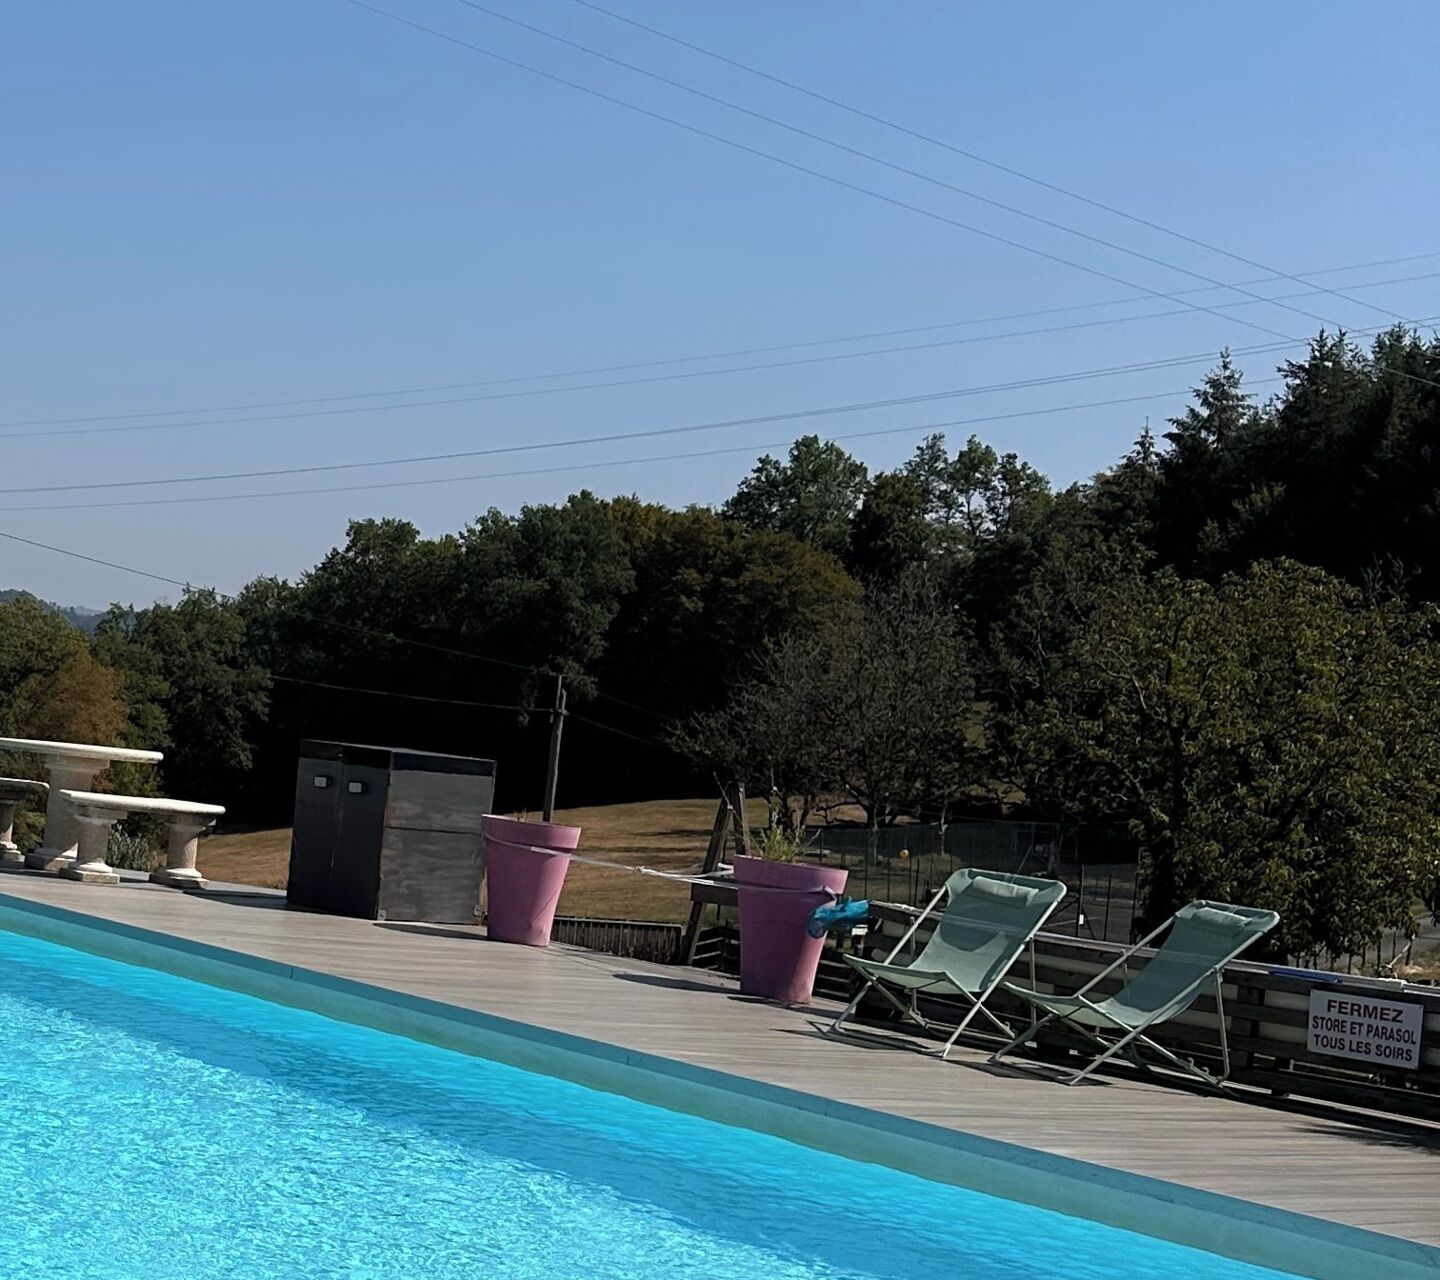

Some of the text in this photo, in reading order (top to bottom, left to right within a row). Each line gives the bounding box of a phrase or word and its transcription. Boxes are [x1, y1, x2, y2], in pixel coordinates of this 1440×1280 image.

[1326, 999, 1404, 1023] FERMEZ
[1312, 1015, 1417, 1045] STORE ET PARASOL
[1314, 1034, 1413, 1062] TOUS LES SOIRS
